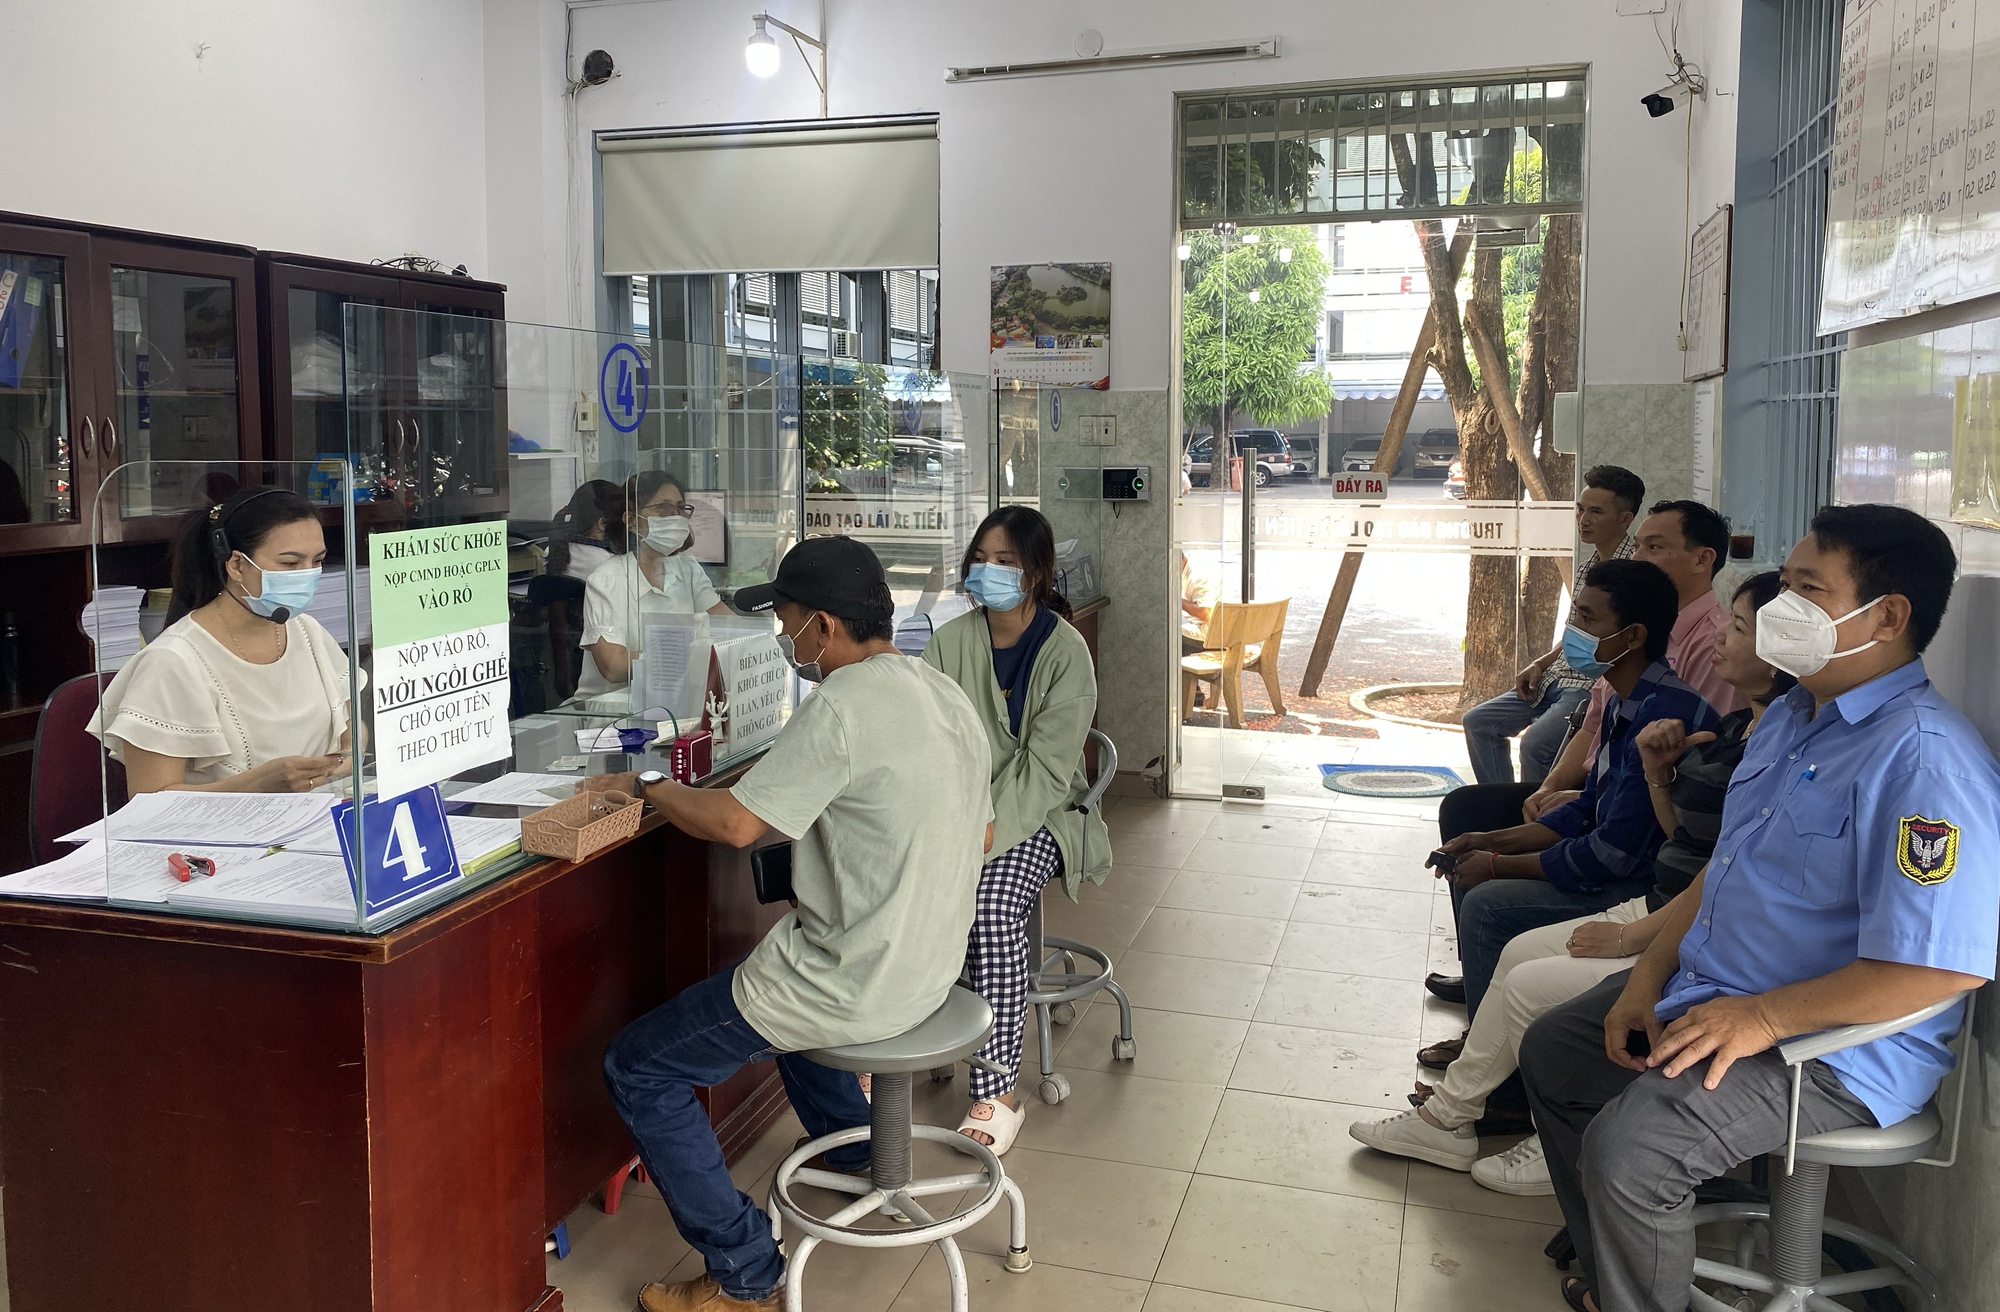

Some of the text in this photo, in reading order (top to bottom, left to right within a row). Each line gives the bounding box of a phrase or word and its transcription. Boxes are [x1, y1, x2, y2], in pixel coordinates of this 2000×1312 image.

[1401, 276, 1412, 293] E
[616, 359, 635, 417] 4
[1336, 474, 1383, 493] ĐẨY RA
[806, 508, 831, 527] ĐÀO
[868, 509, 890, 528] LÁI
[894, 511, 909, 529] XE
[383, 528, 502, 560] KHÁM SỨC KHỎE
[384, 571, 407, 588] NỘP
[409, 567, 441, 583] CMND
[475, 559, 501, 573] GPLX
[418, 588, 449, 610] VÀO
[751, 600, 774, 612] FASHION
[398, 642, 428, 667] NỘP
[432, 634, 464, 658] VÀO
[739, 653, 758, 672] BIÊN
[759, 649, 772, 665] LAI
[377, 651, 508, 709] MỜI NGỒI GHẾ
[737, 673, 760, 694] KHỎE
[399, 690, 491, 733] CHỜ GỌI TÊN
[397, 715, 495, 763] THEO THỨ TỰ
[736, 719, 765, 740] KHÔNG
[381, 800, 433, 882] 4
[1911, 823, 1950, 836] SECURITY
